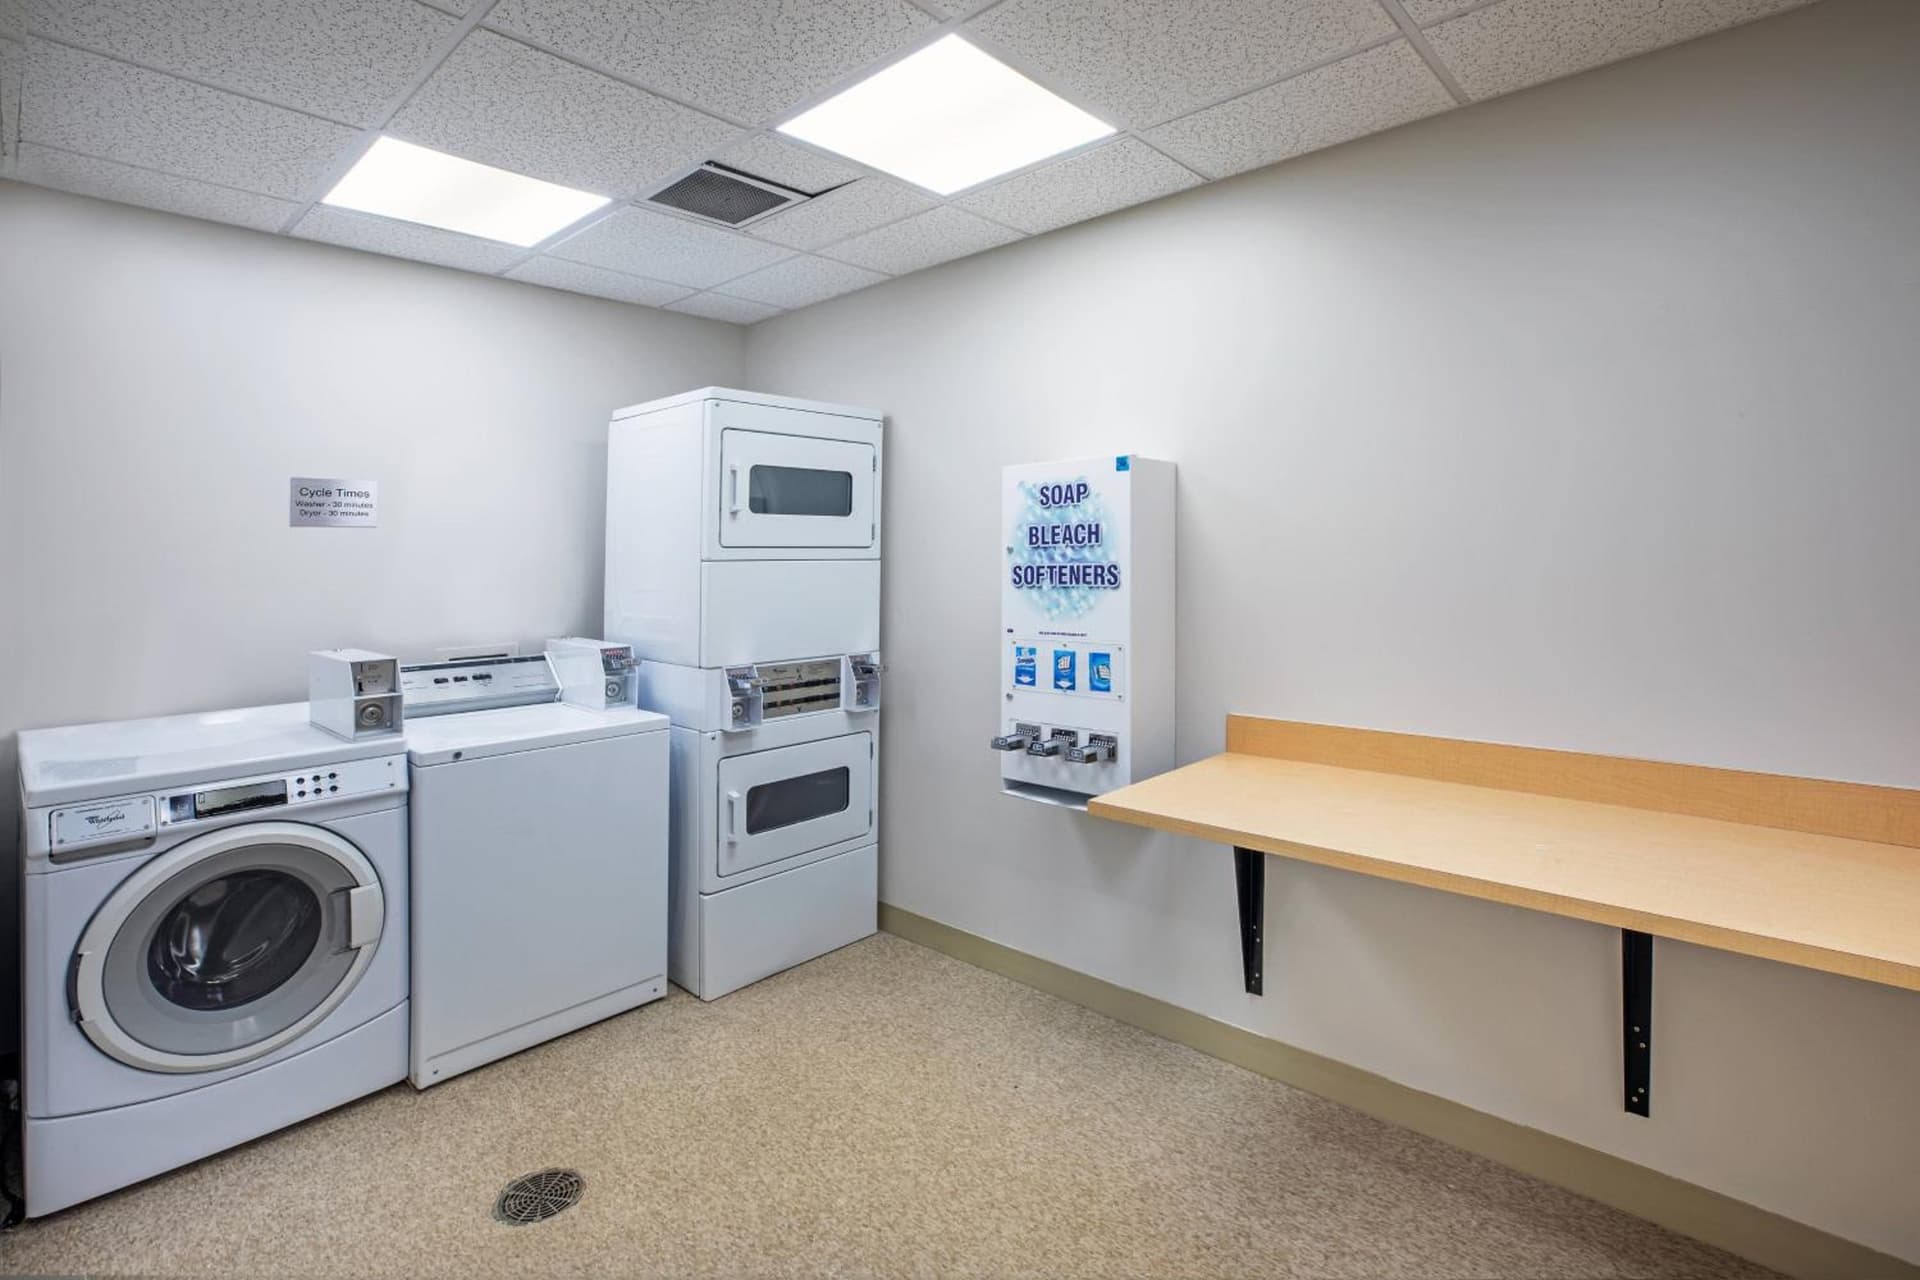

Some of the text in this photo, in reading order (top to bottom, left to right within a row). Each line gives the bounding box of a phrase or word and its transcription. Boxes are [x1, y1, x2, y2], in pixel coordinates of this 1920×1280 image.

[299, 487, 370, 499] Cycle Times
[1039, 482, 1089, 507] SOAP
[295, 500, 325, 508] Washer
[299, 509, 321, 518] Dryer
[1028, 523, 1101, 547] BLEACH
[1012, 564, 1120, 588] SOFTENERS
[1057, 655, 1071, 671] all
